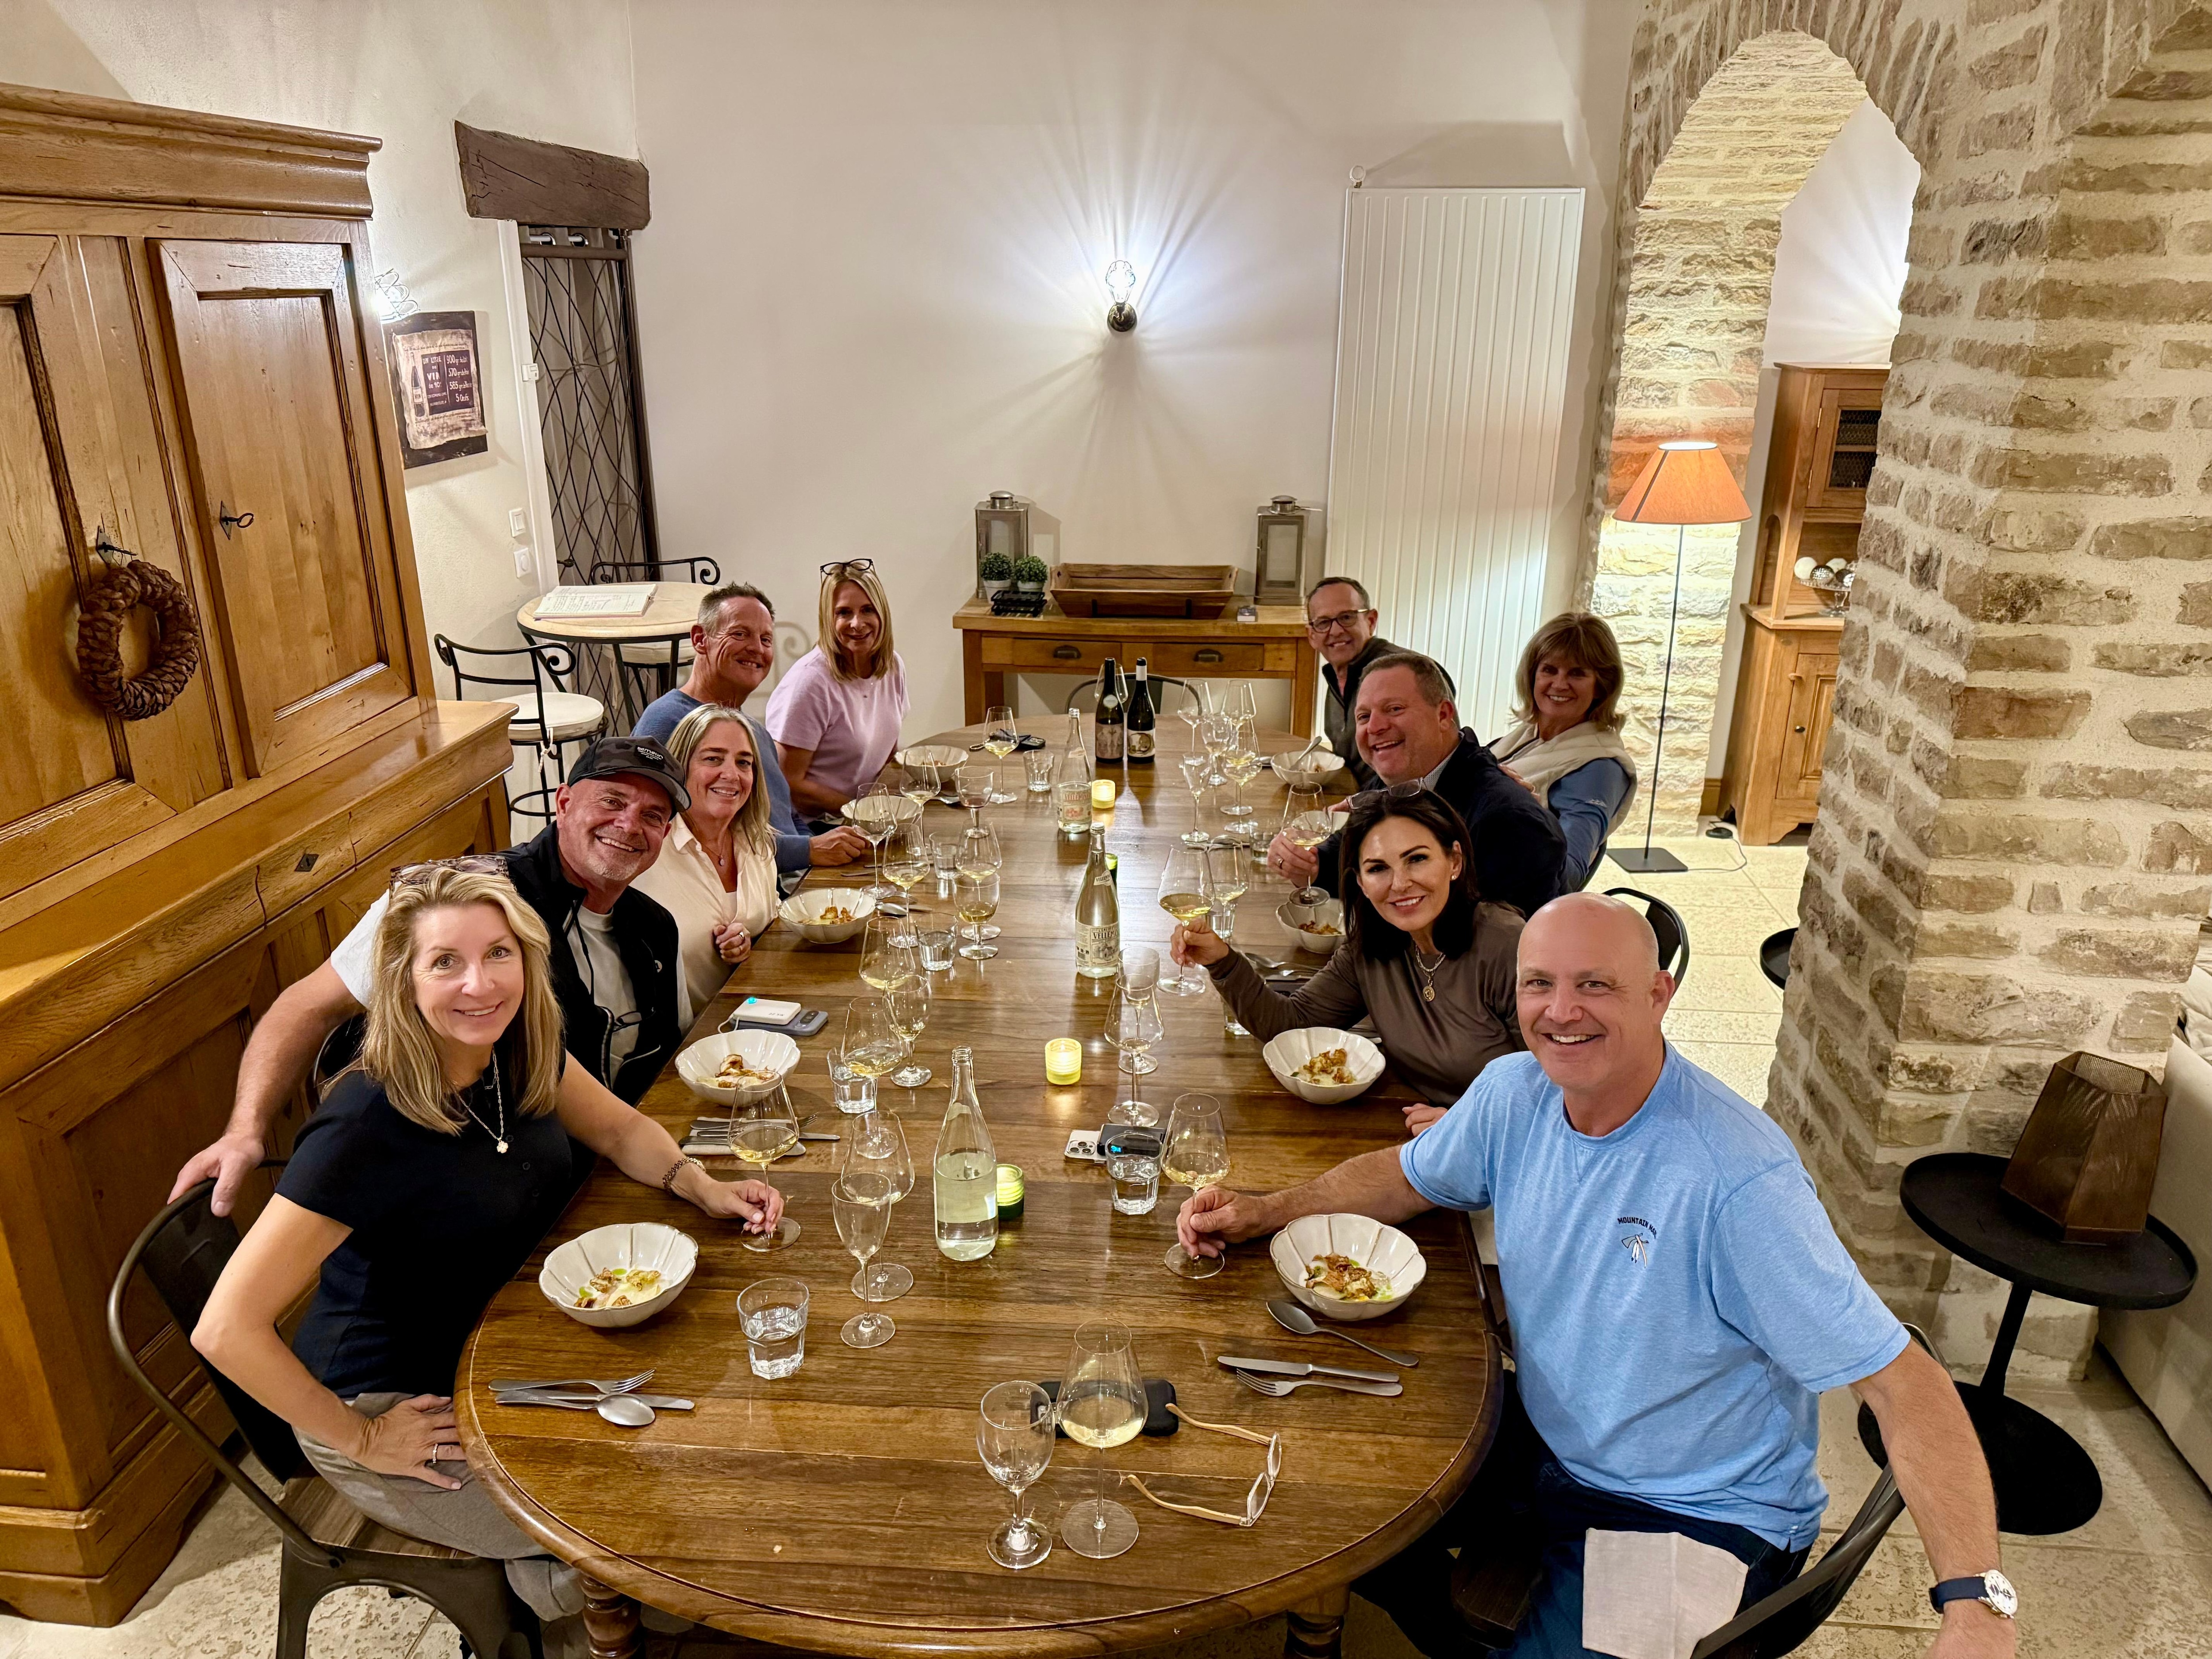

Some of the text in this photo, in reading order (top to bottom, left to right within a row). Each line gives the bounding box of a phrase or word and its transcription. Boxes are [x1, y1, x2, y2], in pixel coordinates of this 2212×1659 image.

[446, 354, 455, 364] 900
[455, 393, 460, 402] 5
[1617, 1217, 1649, 1228] MOUNTAIN
